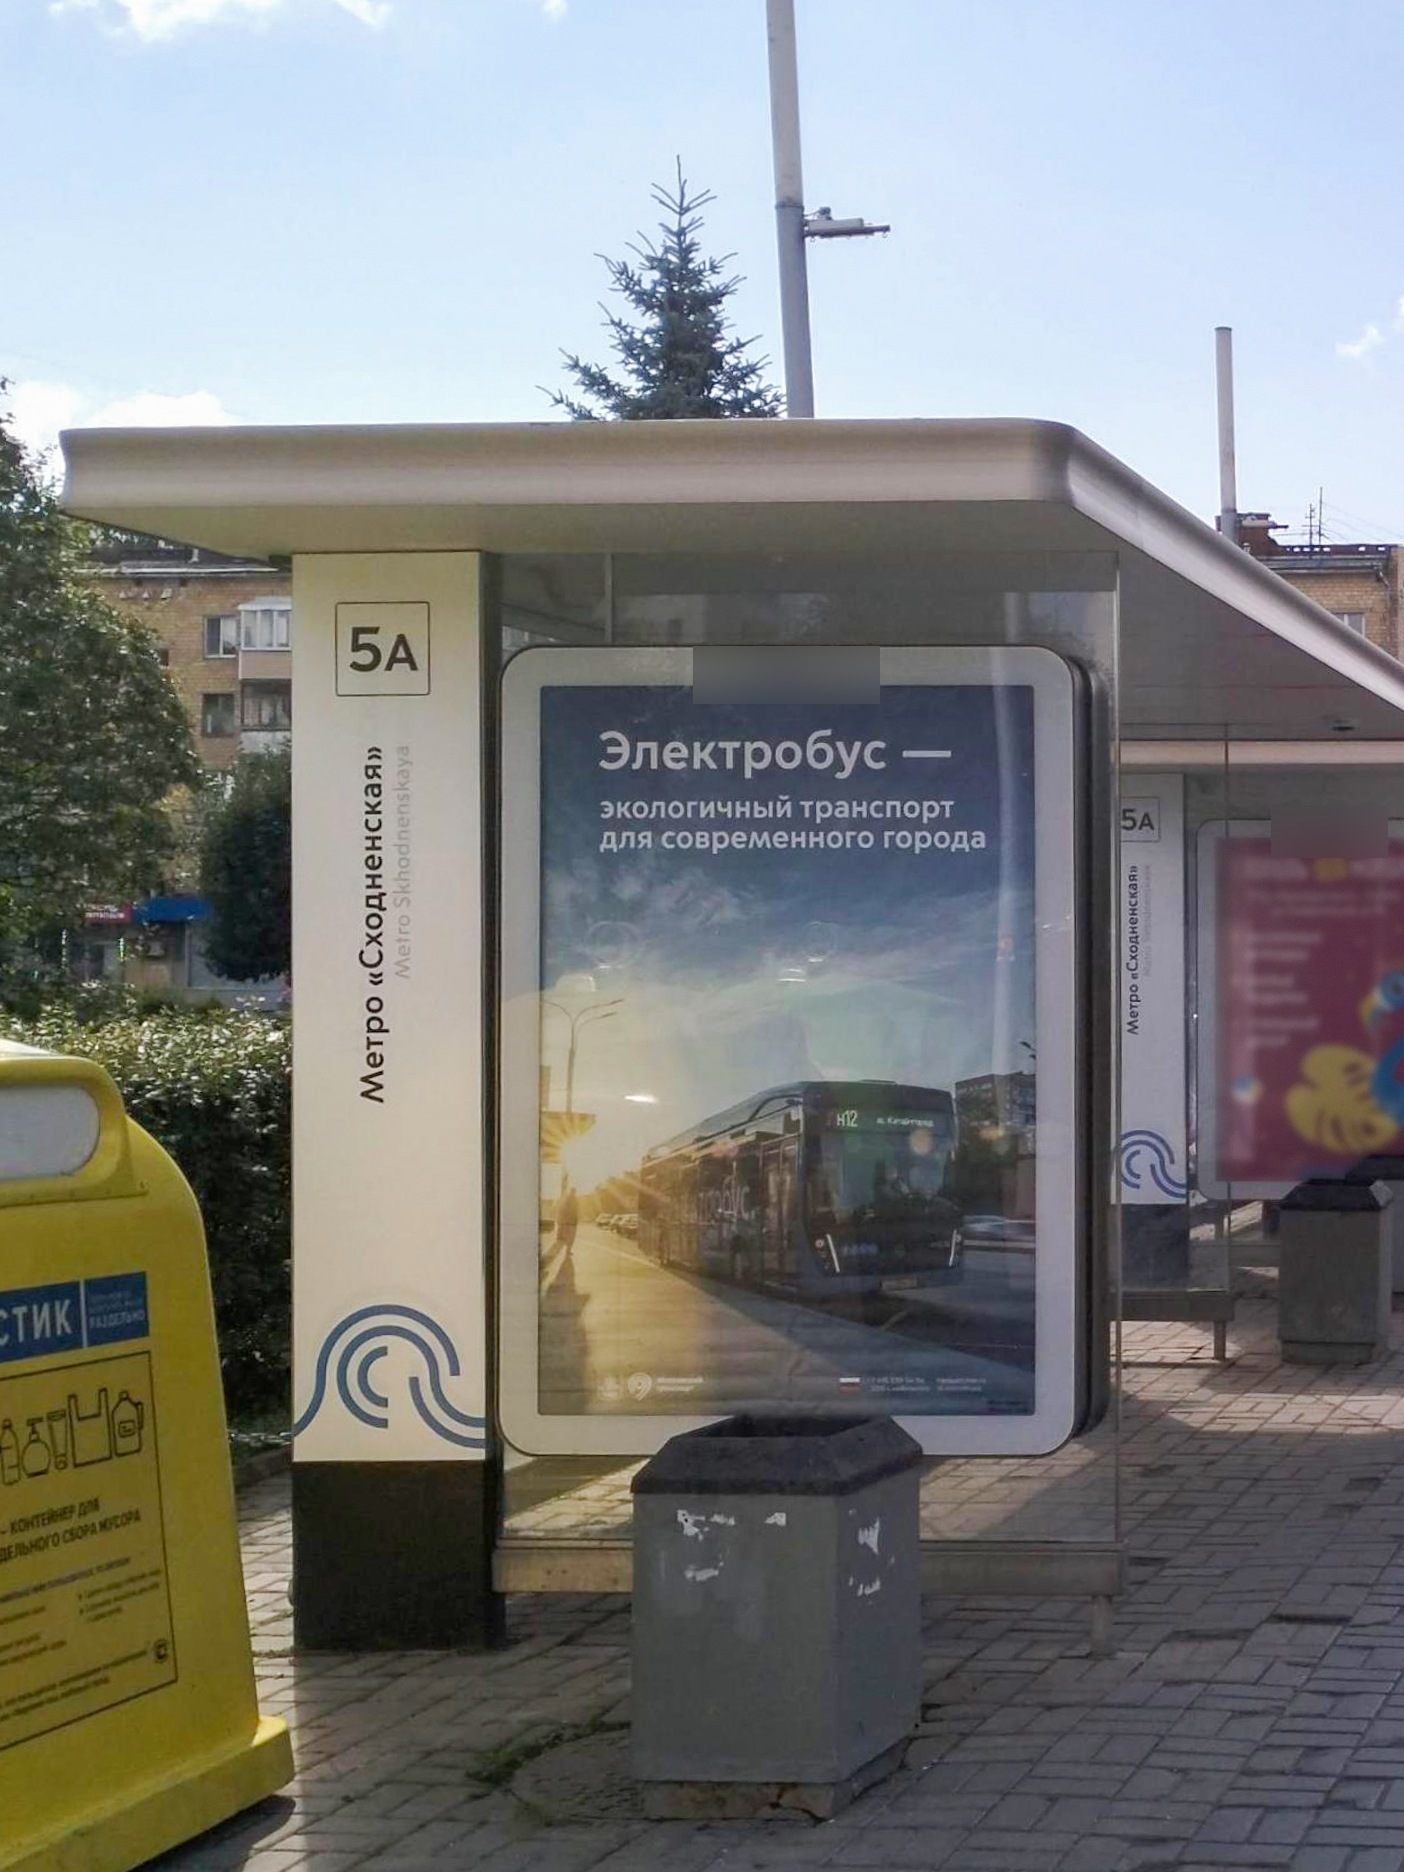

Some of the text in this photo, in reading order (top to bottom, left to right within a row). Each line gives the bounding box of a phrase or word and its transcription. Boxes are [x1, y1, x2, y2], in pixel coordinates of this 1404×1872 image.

[350, 626, 418, 673] 5А
[599, 729, 887, 779] Электробус
[599, 795, 955, 824] экологичный транспорт
[1121, 808, 1155, 831] 5А
[392, 745, 412, 980] Metro Skhodnenskaya
[599, 829, 987, 854] для современного города
[359, 746, 390, 1103] Метро «Сходненская»
[1126, 865, 1142, 1035] Метро «Сходненская»
[62, 1522, 97, 1544] СБОРА
[98, 1508, 142, 1532] МУСОРА
